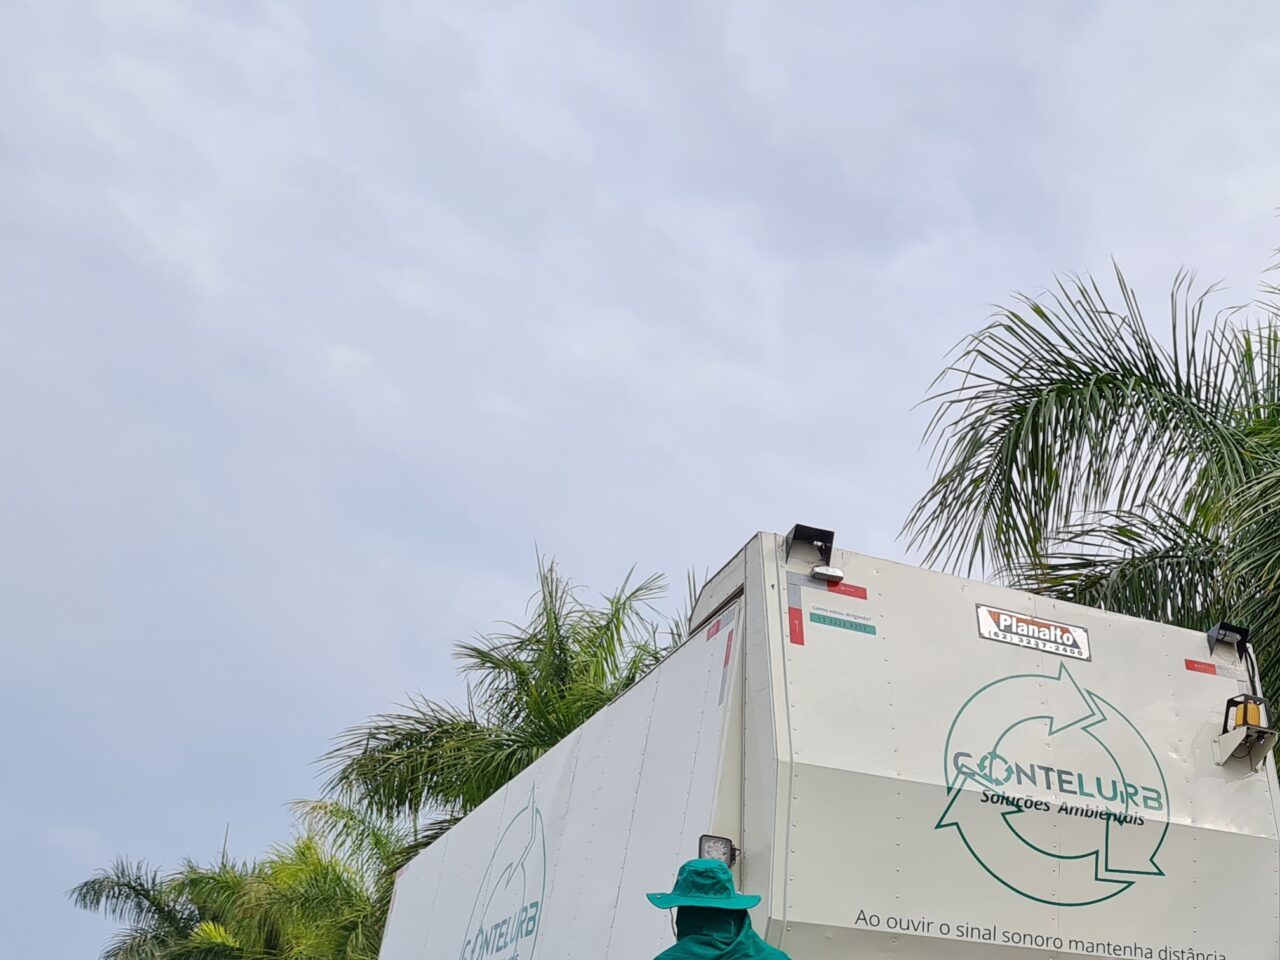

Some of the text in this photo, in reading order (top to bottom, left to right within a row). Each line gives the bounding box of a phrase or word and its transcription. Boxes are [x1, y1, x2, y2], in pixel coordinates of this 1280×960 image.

[988, 629, 1013, 643] (62)
[999, 612, 1074, 646] Planalto
[980, 787, 1146, 827] Soluções Ambientais
[854, 908, 881, 928] Ao
[886, 915, 935, 934] ouvir
[939, 922, 951, 936] o
[956, 922, 997, 942] sinal
[1001, 930, 1063, 951] sonoro
[1068, 938, 1153, 960] mantenha
